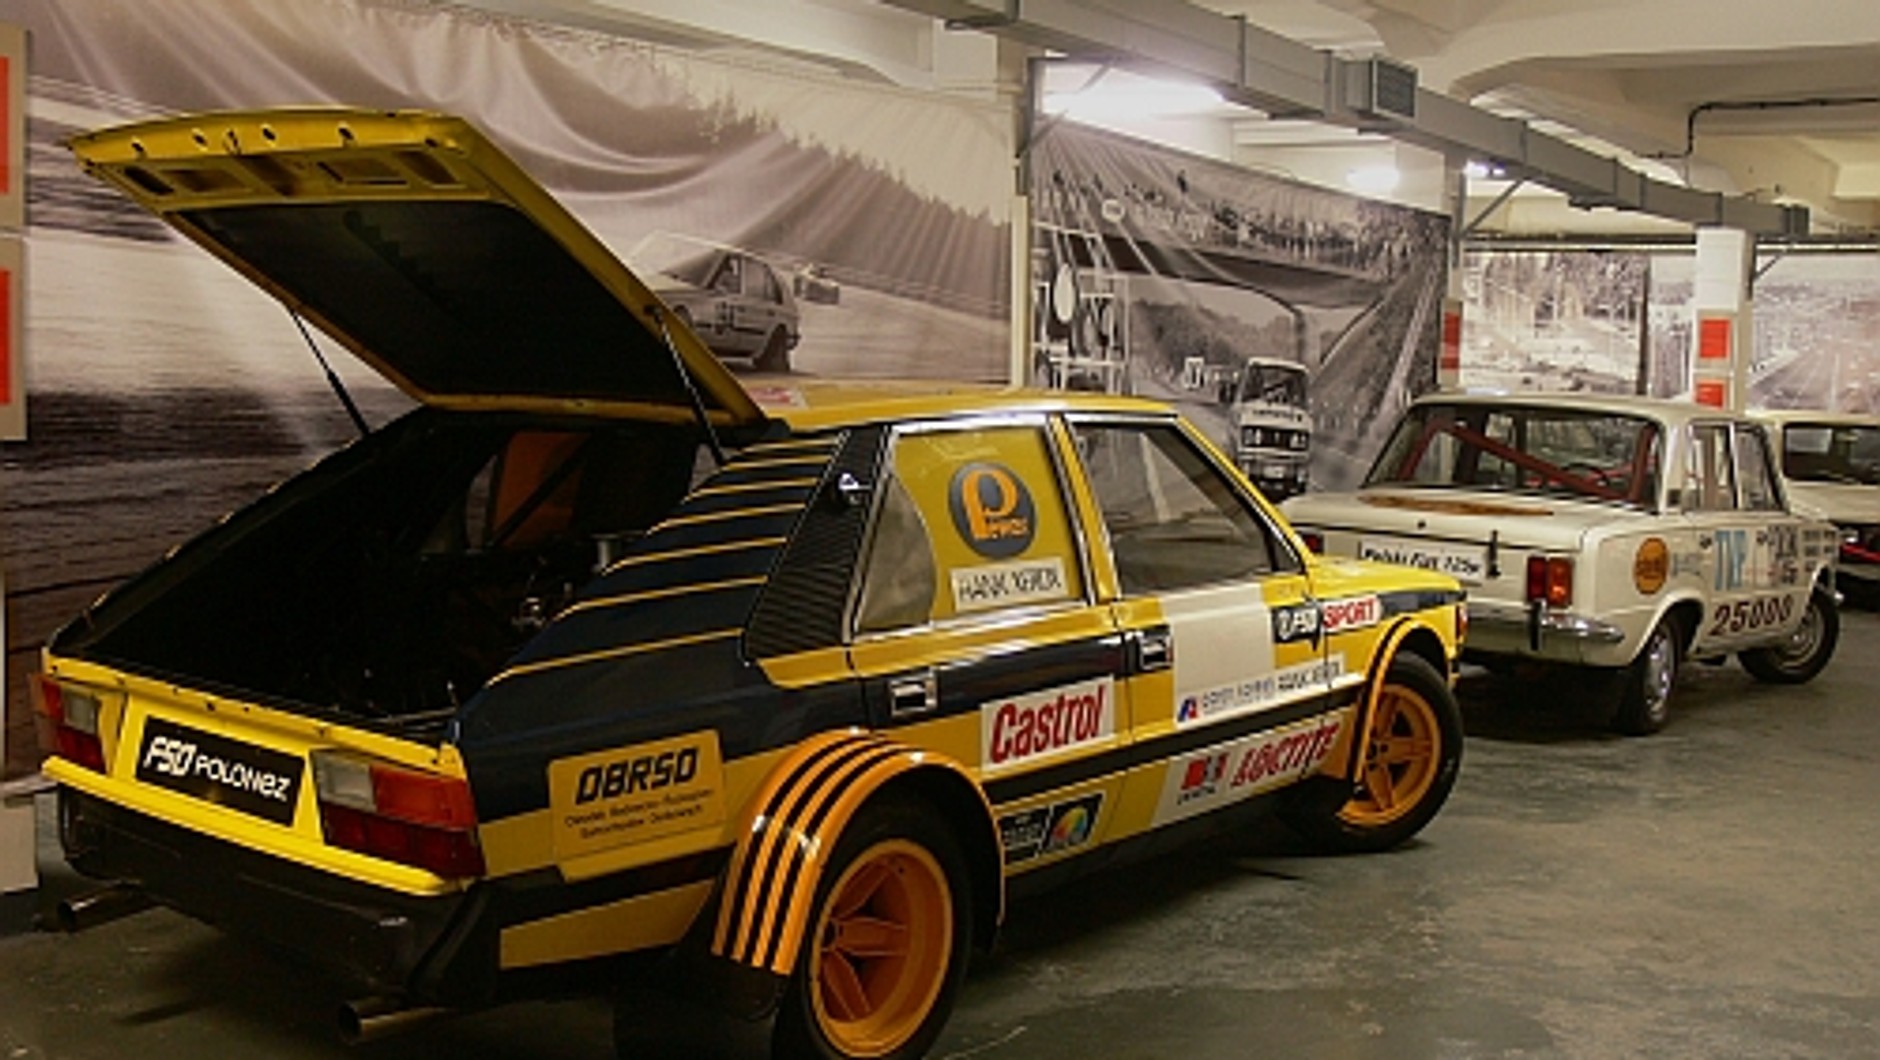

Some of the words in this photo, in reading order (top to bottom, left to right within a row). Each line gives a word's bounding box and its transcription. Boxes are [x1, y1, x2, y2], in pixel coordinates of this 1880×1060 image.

[1323, 597, 1375, 630] SPORT
[1708, 594, 1794, 637] 25000
[990, 684, 1106, 764] Castrol
